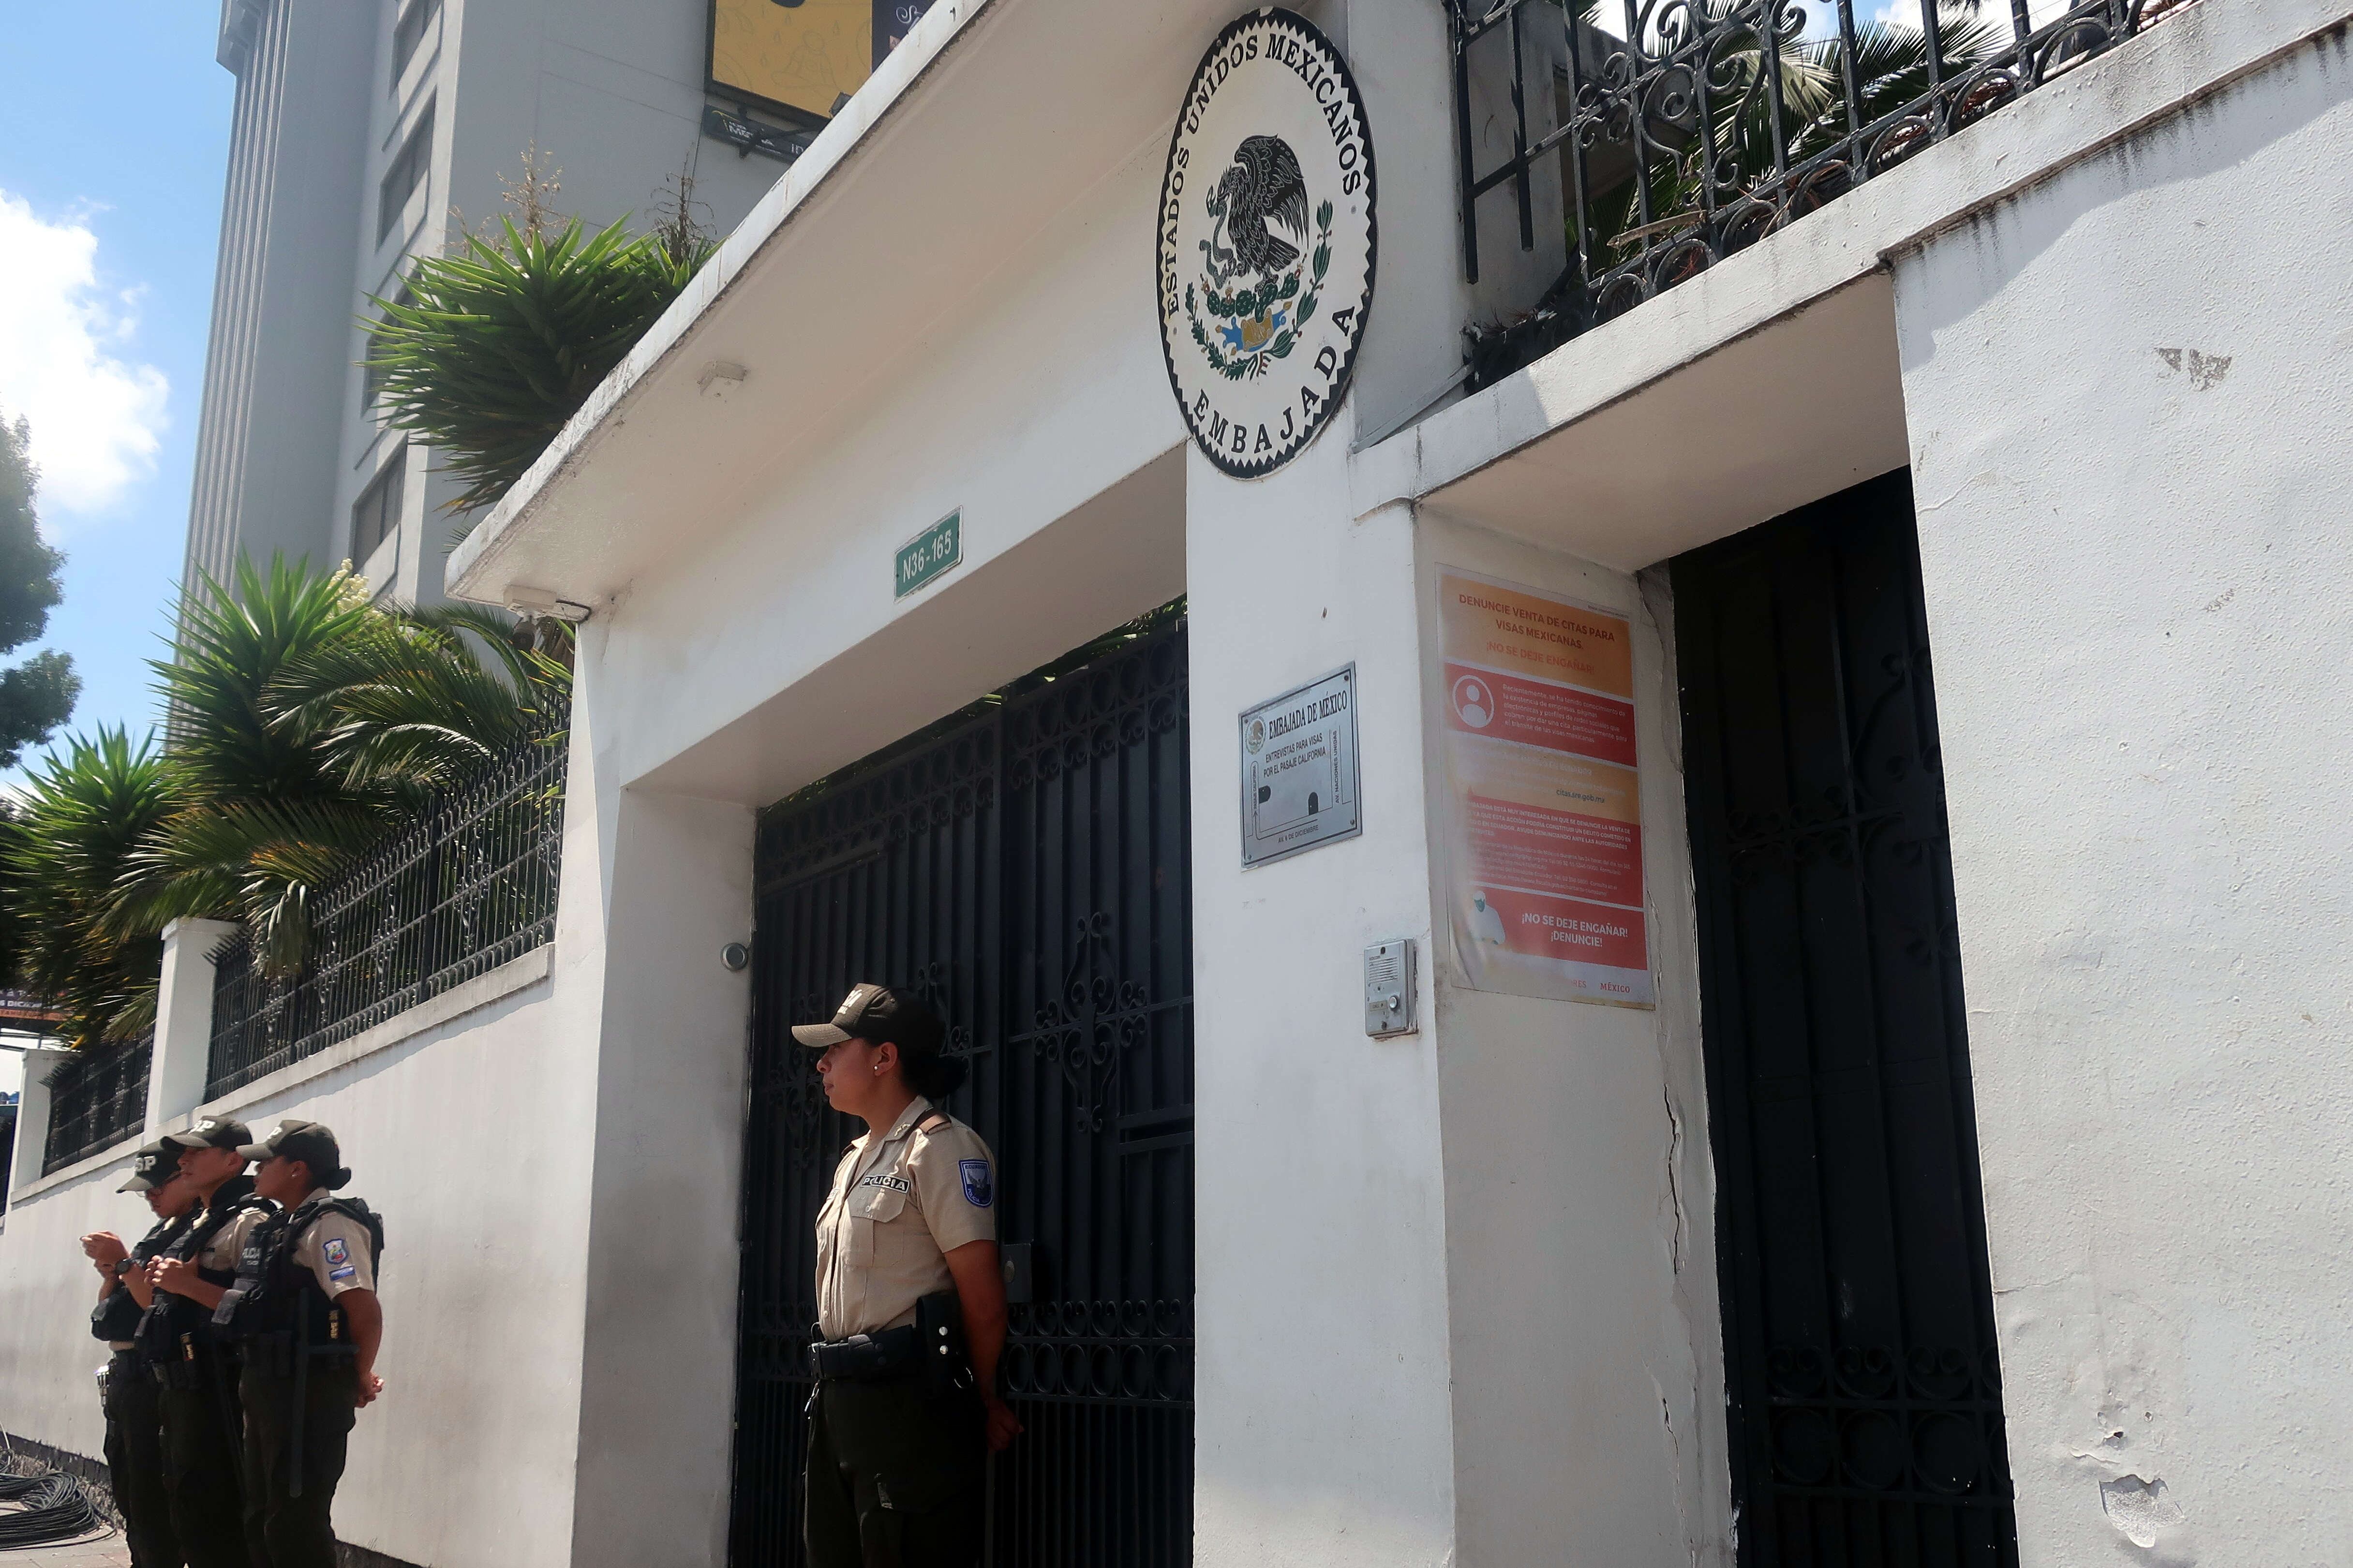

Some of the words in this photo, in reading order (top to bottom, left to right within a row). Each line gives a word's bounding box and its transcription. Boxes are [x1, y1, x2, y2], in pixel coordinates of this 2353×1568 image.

[1164, 147, 1190, 319] ESTADOS
[1186, 34, 1258, 134] UNIDOS
[1265, 33, 1361, 195] MEXICANOS
[1193, 306, 1355, 454] EMBAJADA
[903, 529, 952, 583] N36-165
[1459, 594, 1510, 615] DENUNCIE
[1512, 606, 1545, 623] VENTA
[1547, 616, 1560, 627] DE
[1562, 620, 1587, 635] CITAS
[1589, 627, 1615, 642] PARA
[1496, 619, 1524, 635] VISAS
[1526, 628, 1584, 650] MEXICANAS.
[1486, 641, 1504, 653] ¡NO
[1505, 645, 1518, 656] SE
[1520, 649, 1545, 663] DEJE
[1269, 708, 1306, 740] EMBAJADA
[1307, 703, 1318, 724] DE
[1319, 690, 1347, 719] MÉXICO
[1264, 767, 1273, 778] POR
[1274, 764, 1280, 774] EL
[1280, 756, 1297, 772] PASAJE
[1298, 746, 1326, 765] CALIFORNIA
[1266, 743, 1296, 763] ENTREVISTAS
[1296, 739, 1308, 751] PARA
[1309, 733, 1323, 746] VISAS
[1295, 825, 1319, 837] DICIEMBRE
[1521, 913, 1540, 924] ¡NO
[1542, 915, 1554, 926] SE
[1556, 917, 1578, 930] DEJE
[1580, 921, 1628, 937] ENGAÑAR!
[1551, 931, 1603, 947] ¡DENUNCIE!
[1600, 982, 1630, 993] MÉXICO
